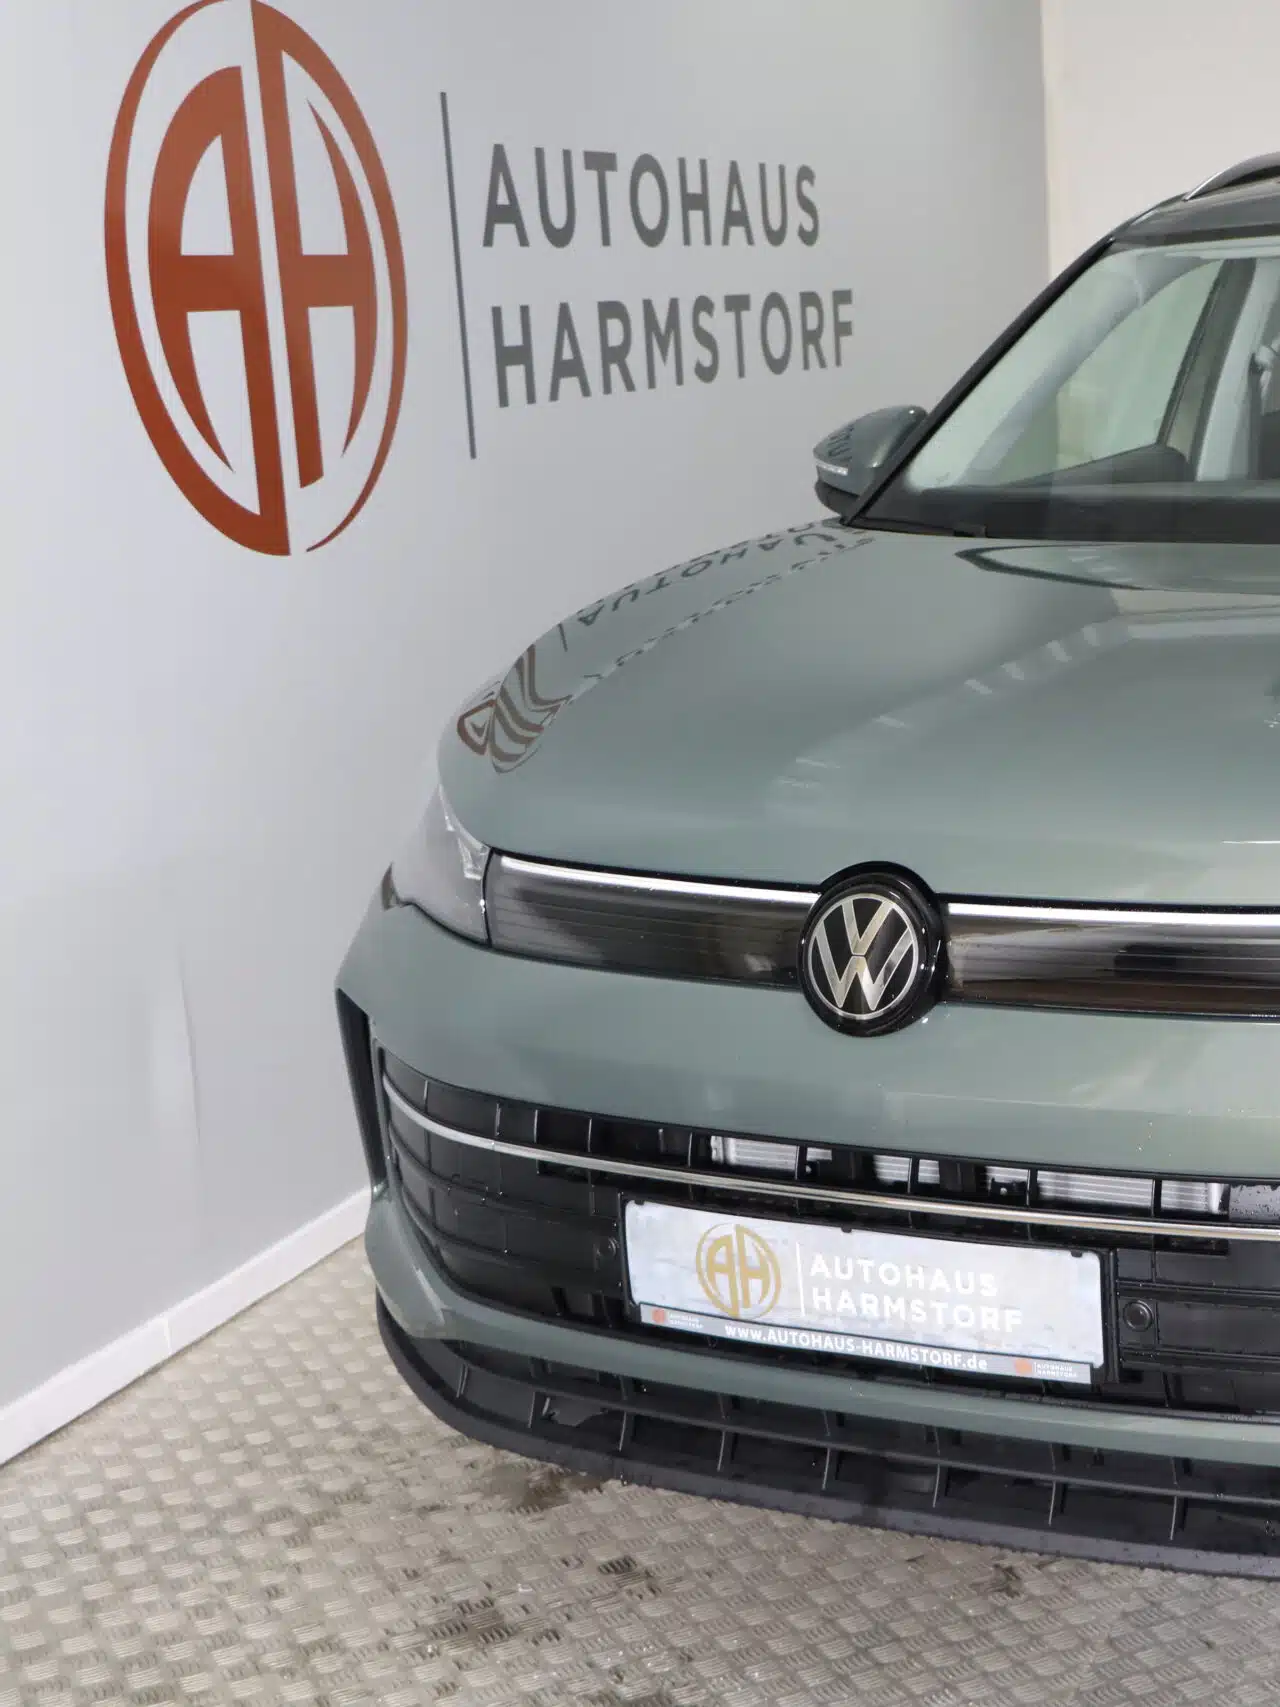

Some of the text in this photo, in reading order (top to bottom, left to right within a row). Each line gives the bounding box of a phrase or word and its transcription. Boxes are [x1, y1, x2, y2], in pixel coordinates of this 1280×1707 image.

[482, 143, 820, 248] AUTOHAUS
[490, 289, 855, 408] HARMSTORF
[809, 893, 918, 1020] VW
[810, 1252, 998, 1297] AUTOHAUS
[812, 1287, 1022, 1333] HARMSTORF
[724, 1325, 988, 1370] www.AUTOHAUS-HARMSTORF.de
